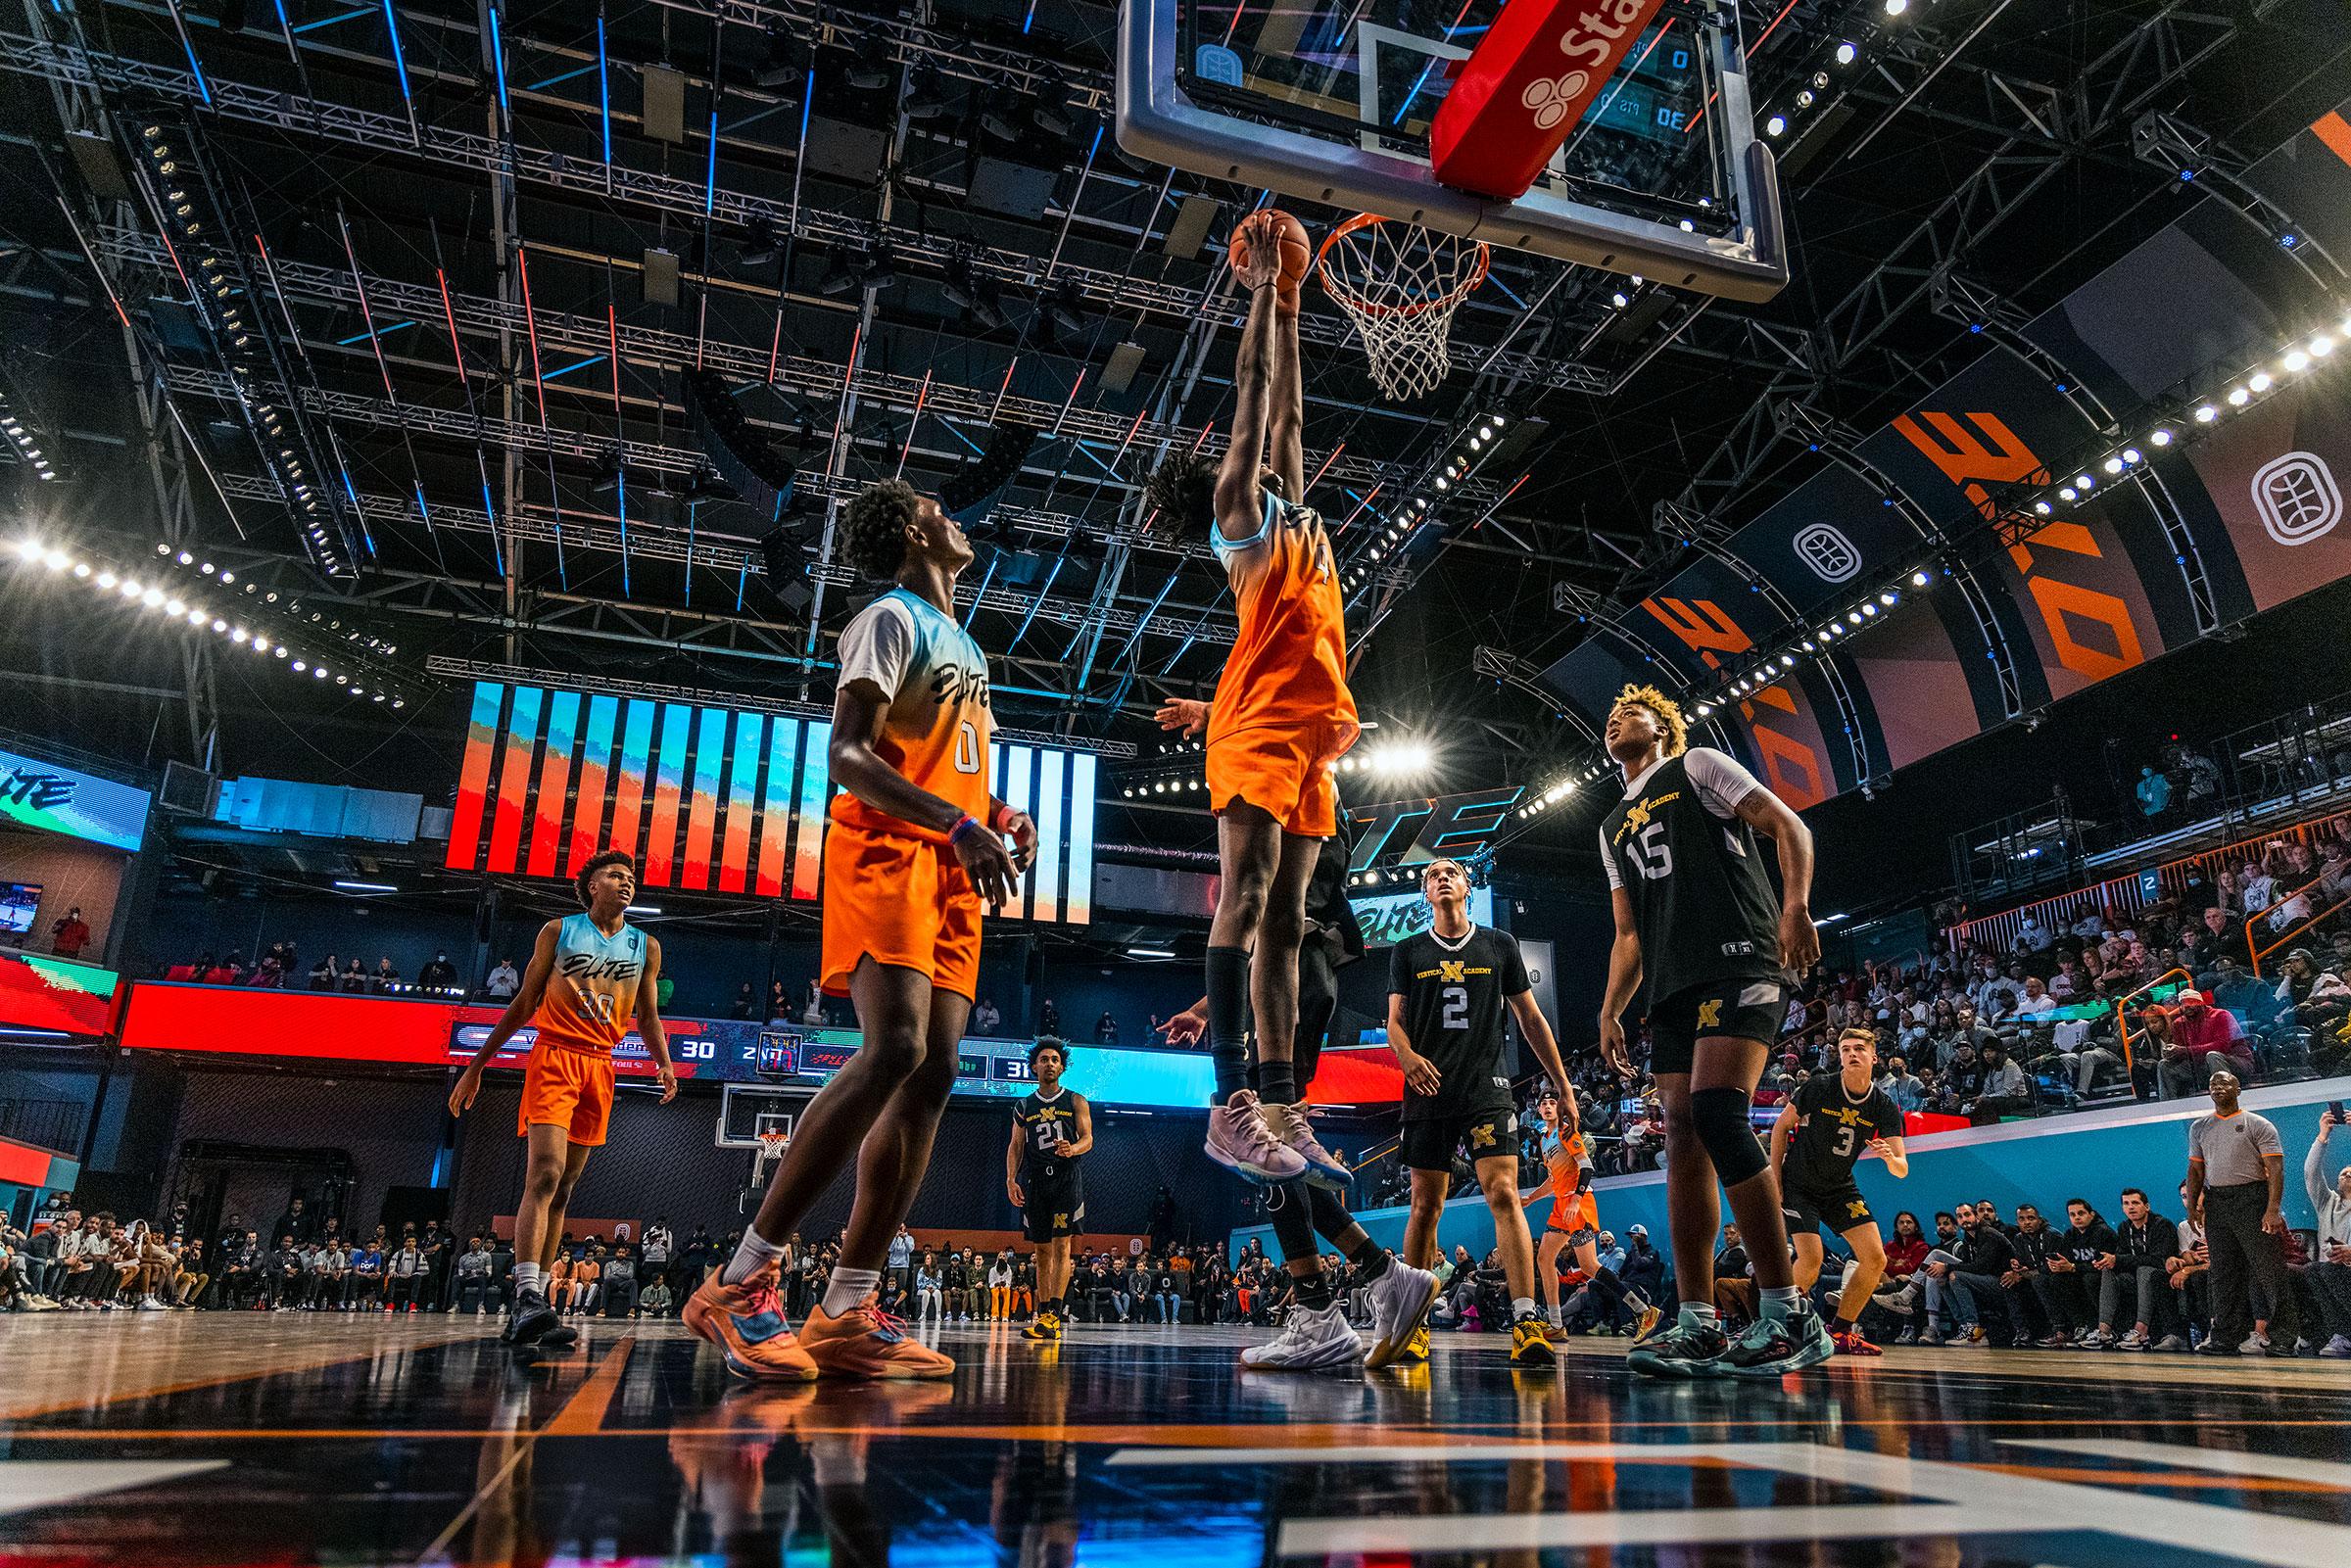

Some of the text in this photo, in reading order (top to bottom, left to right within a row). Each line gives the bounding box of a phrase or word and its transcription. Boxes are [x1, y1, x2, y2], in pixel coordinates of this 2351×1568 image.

[1647, 791, 1681, 811] ACADEMY
[1626, 821, 1673, 880] 15
[577, 987, 616, 1026] 30
[1443, 986, 1469, 1029] 2
[682, 1040, 716, 1060] 30
[1035, 1120, 1064, 1151] 21
[1832, 1126, 1855, 1157] 3
